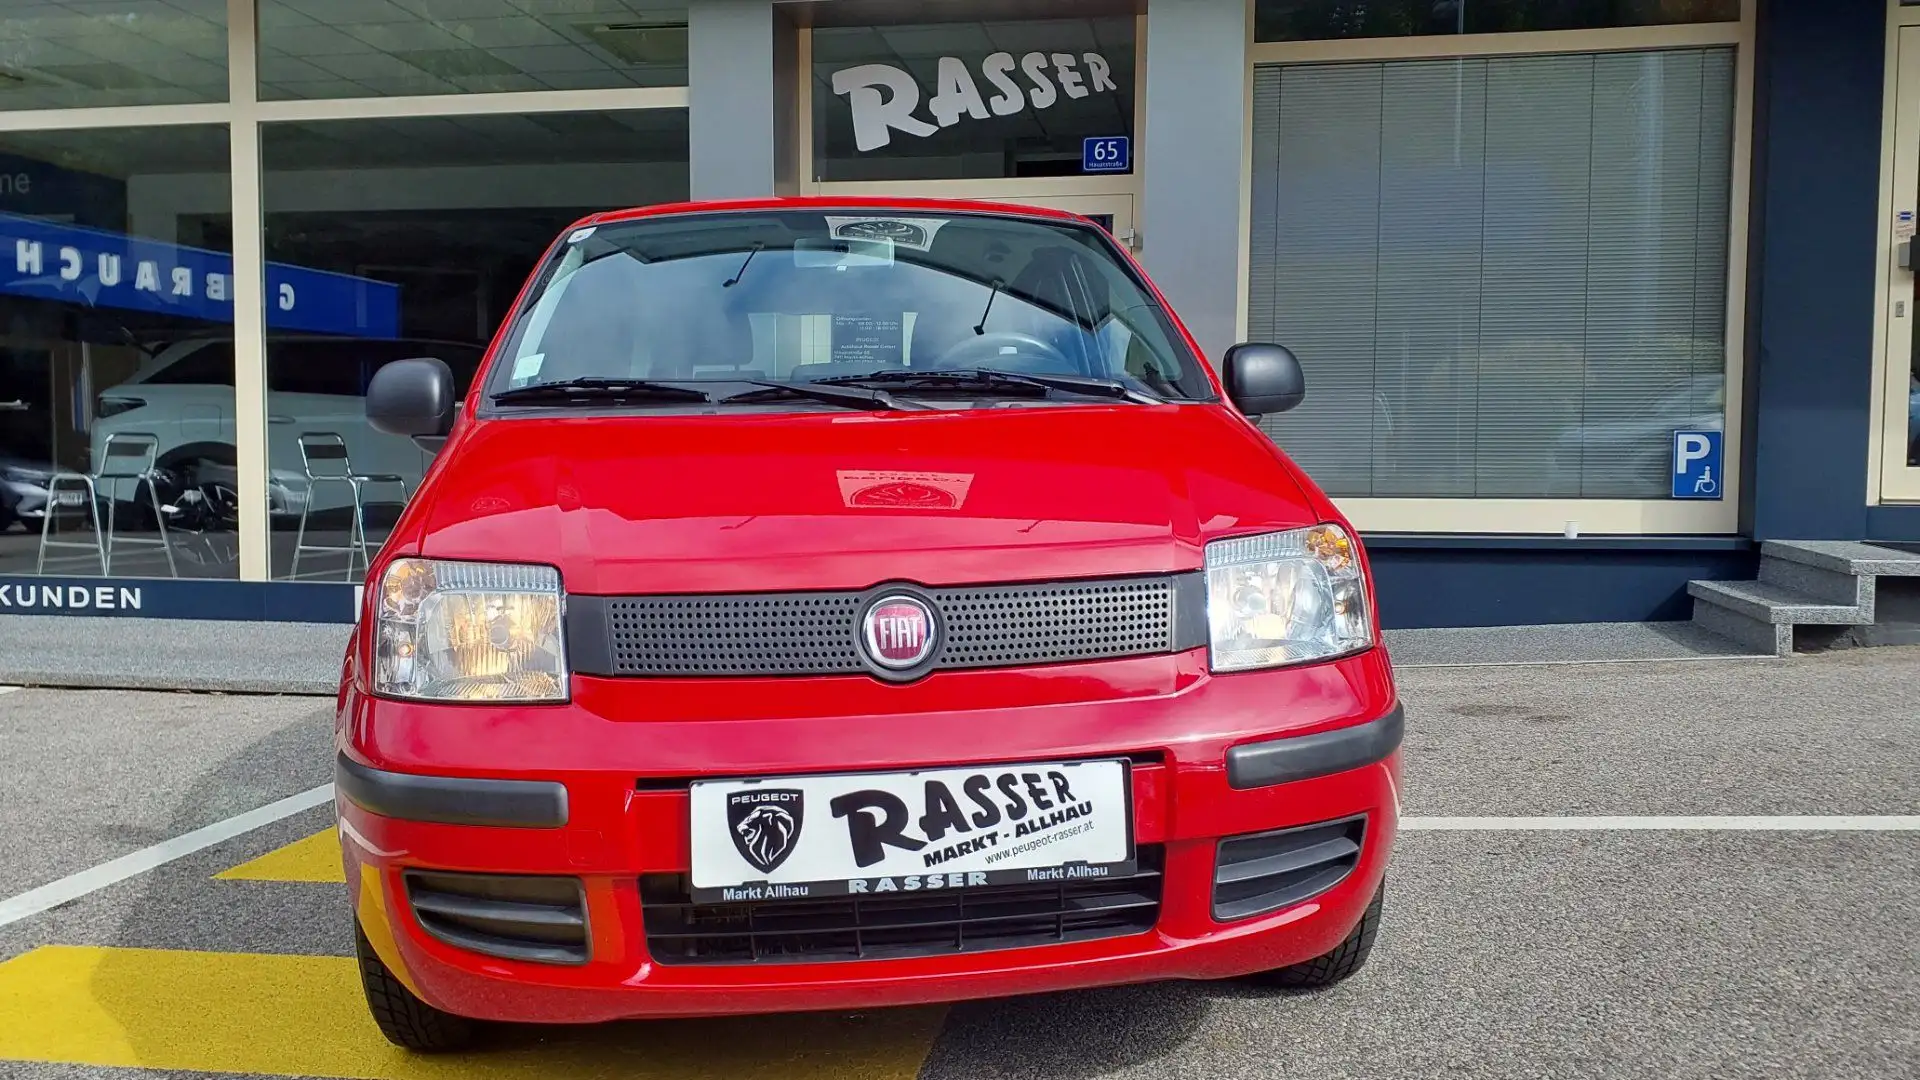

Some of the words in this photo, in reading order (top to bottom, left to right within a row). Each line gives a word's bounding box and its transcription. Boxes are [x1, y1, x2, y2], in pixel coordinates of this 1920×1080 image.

[832, 52, 1117, 151] RASSER
[1094, 142, 1118, 160] 65
[1677, 434, 1711, 474] P
[0, 584, 141, 609] KUNDEN
[880, 615, 921, 650] FIAT
[731, 793, 799, 805] PEUGEOT
[830, 771, 1077, 868] RASSER
[923, 831, 999, 868] MARKT
[1015, 800, 1093, 838] ALLHAU
[985, 819, 1095, 865] www.peugeot-rasser.at
[848, 871, 989, 893] RASSER
[1027, 867, 1064, 881] Markt
[1067, 865, 1109, 878] Allhau
[723, 887, 762, 901] Markt
[764, 885, 809, 898] Allhau
